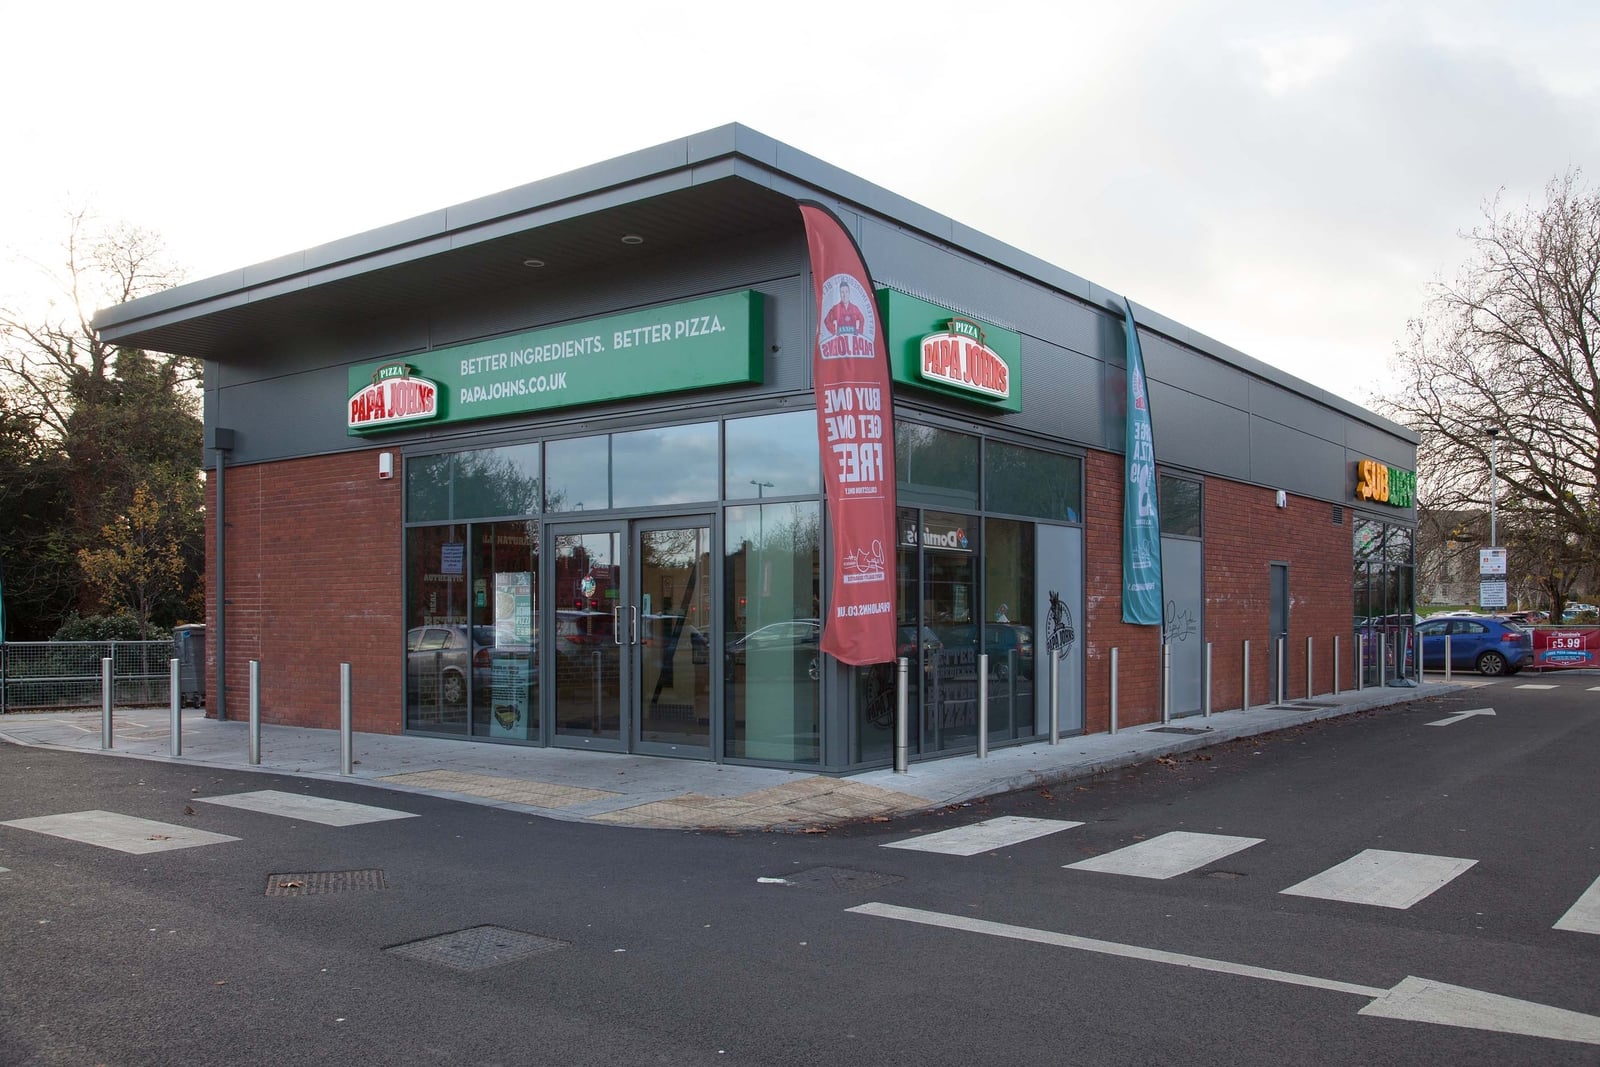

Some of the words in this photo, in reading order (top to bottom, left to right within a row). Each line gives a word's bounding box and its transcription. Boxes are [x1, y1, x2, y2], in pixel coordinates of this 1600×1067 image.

[460, 353, 507, 376] BETTER
[510, 335, 605, 368] INGREDIENTS.
[613, 325, 672, 350] BETTER
[675, 314, 726, 339] PIZZA.
[955, 321, 979, 339] PIZZA
[380, 366, 403, 378] PIZZA
[924, 339, 962, 381] PAPA
[351, 385, 386, 423] PAPA
[460, 372, 567, 404] PAPAJOHNS.CO.UK
[1357, 459, 1415, 508] SUBWAY
[1552, 638, 1580, 649] £5.99
